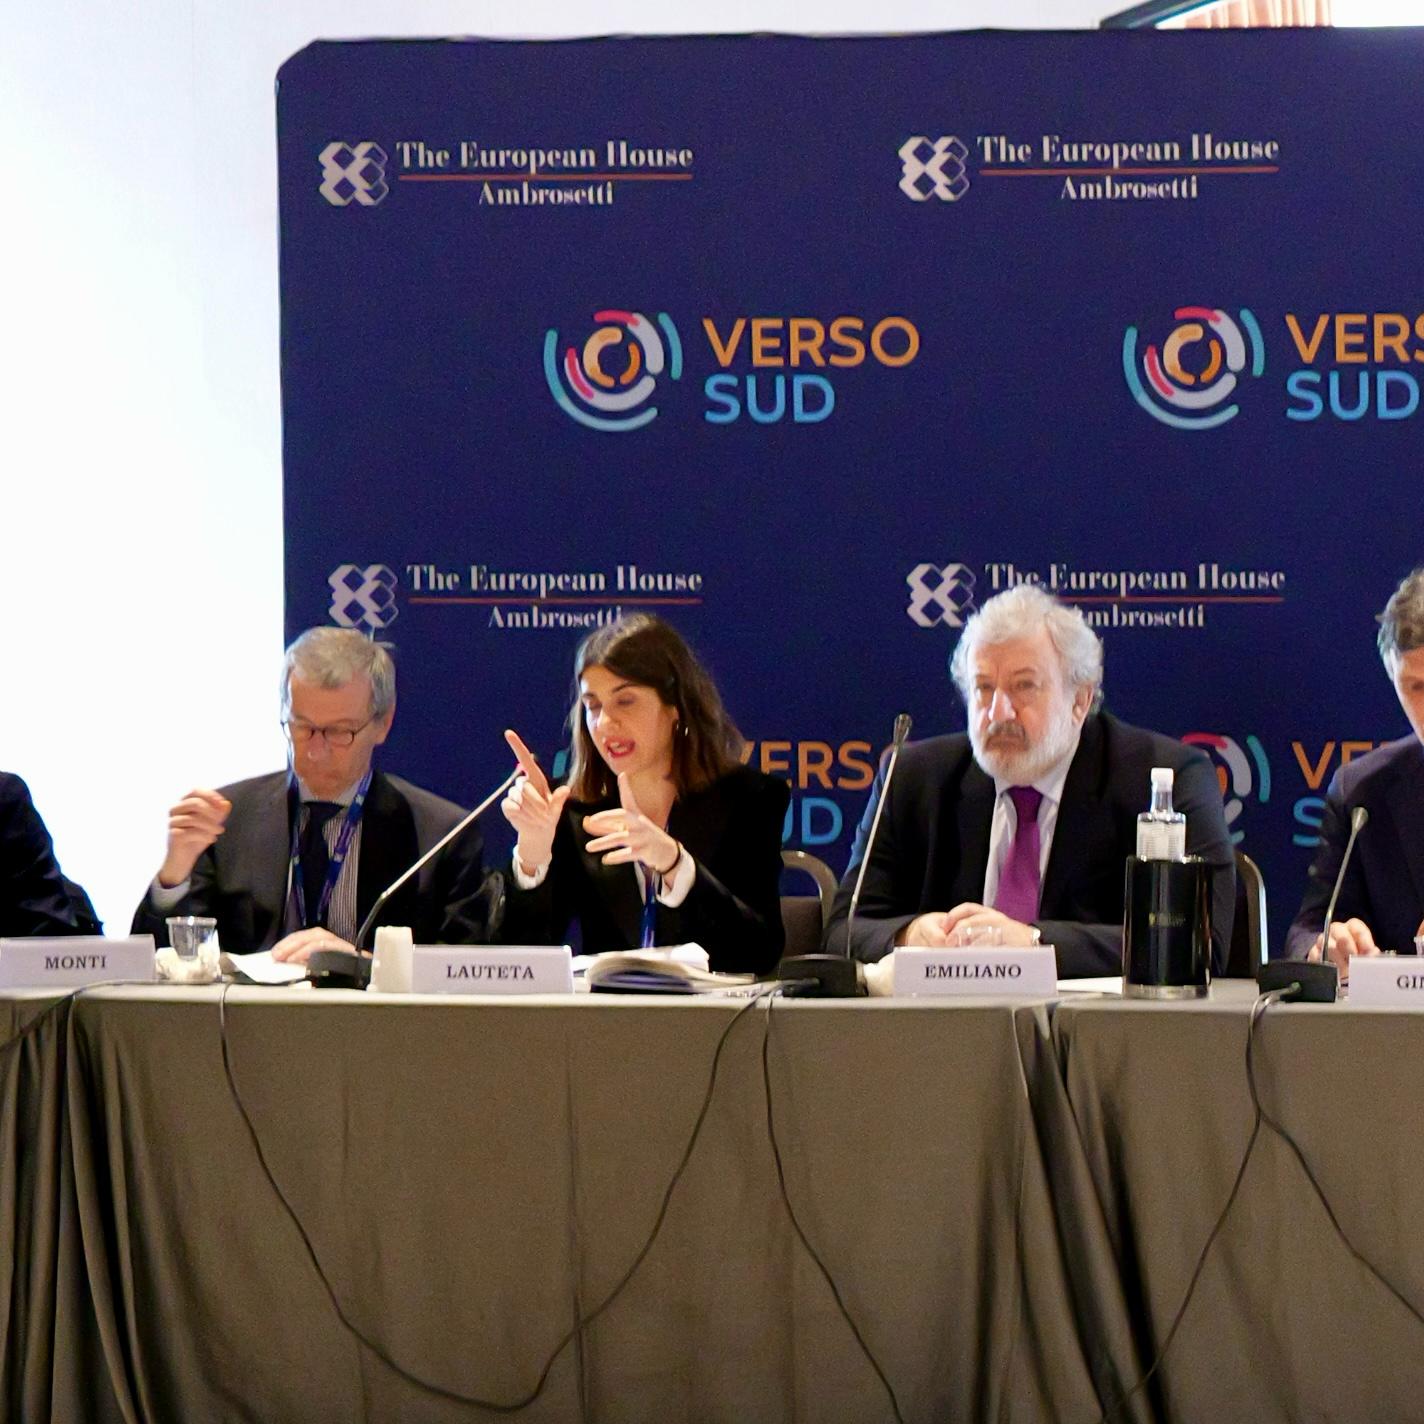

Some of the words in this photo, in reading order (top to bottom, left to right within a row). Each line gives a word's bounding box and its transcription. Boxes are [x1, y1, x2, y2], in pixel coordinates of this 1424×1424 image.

[396, 141, 450, 168] The
[460, 141, 596, 172] European
[607, 140, 693, 167] House
[976, 135, 1032, 163] The
[1042, 135, 1180, 167] European
[1191, 133, 1279, 161] House
[477, 182, 613, 205] Ambrosetti
[1060, 174, 1198, 200] Ambrosetti
[703, 317, 920, 367] VERSO
[704, 374, 835, 423] SUD
[1286, 370, 1420, 420] SUD
[406, 564, 460, 591] The
[470, 564, 606, 599] European
[616, 564, 702, 591] House
[1049, 563, 1187, 597] European
[1198, 563, 1286, 589] House
[1076, 604, 1204, 628] mbrosetti
[45, 955, 106, 971] MONTI
[446, 964, 535, 980] LAUTETA
[924, 963, 1022, 980] EMILIANO
